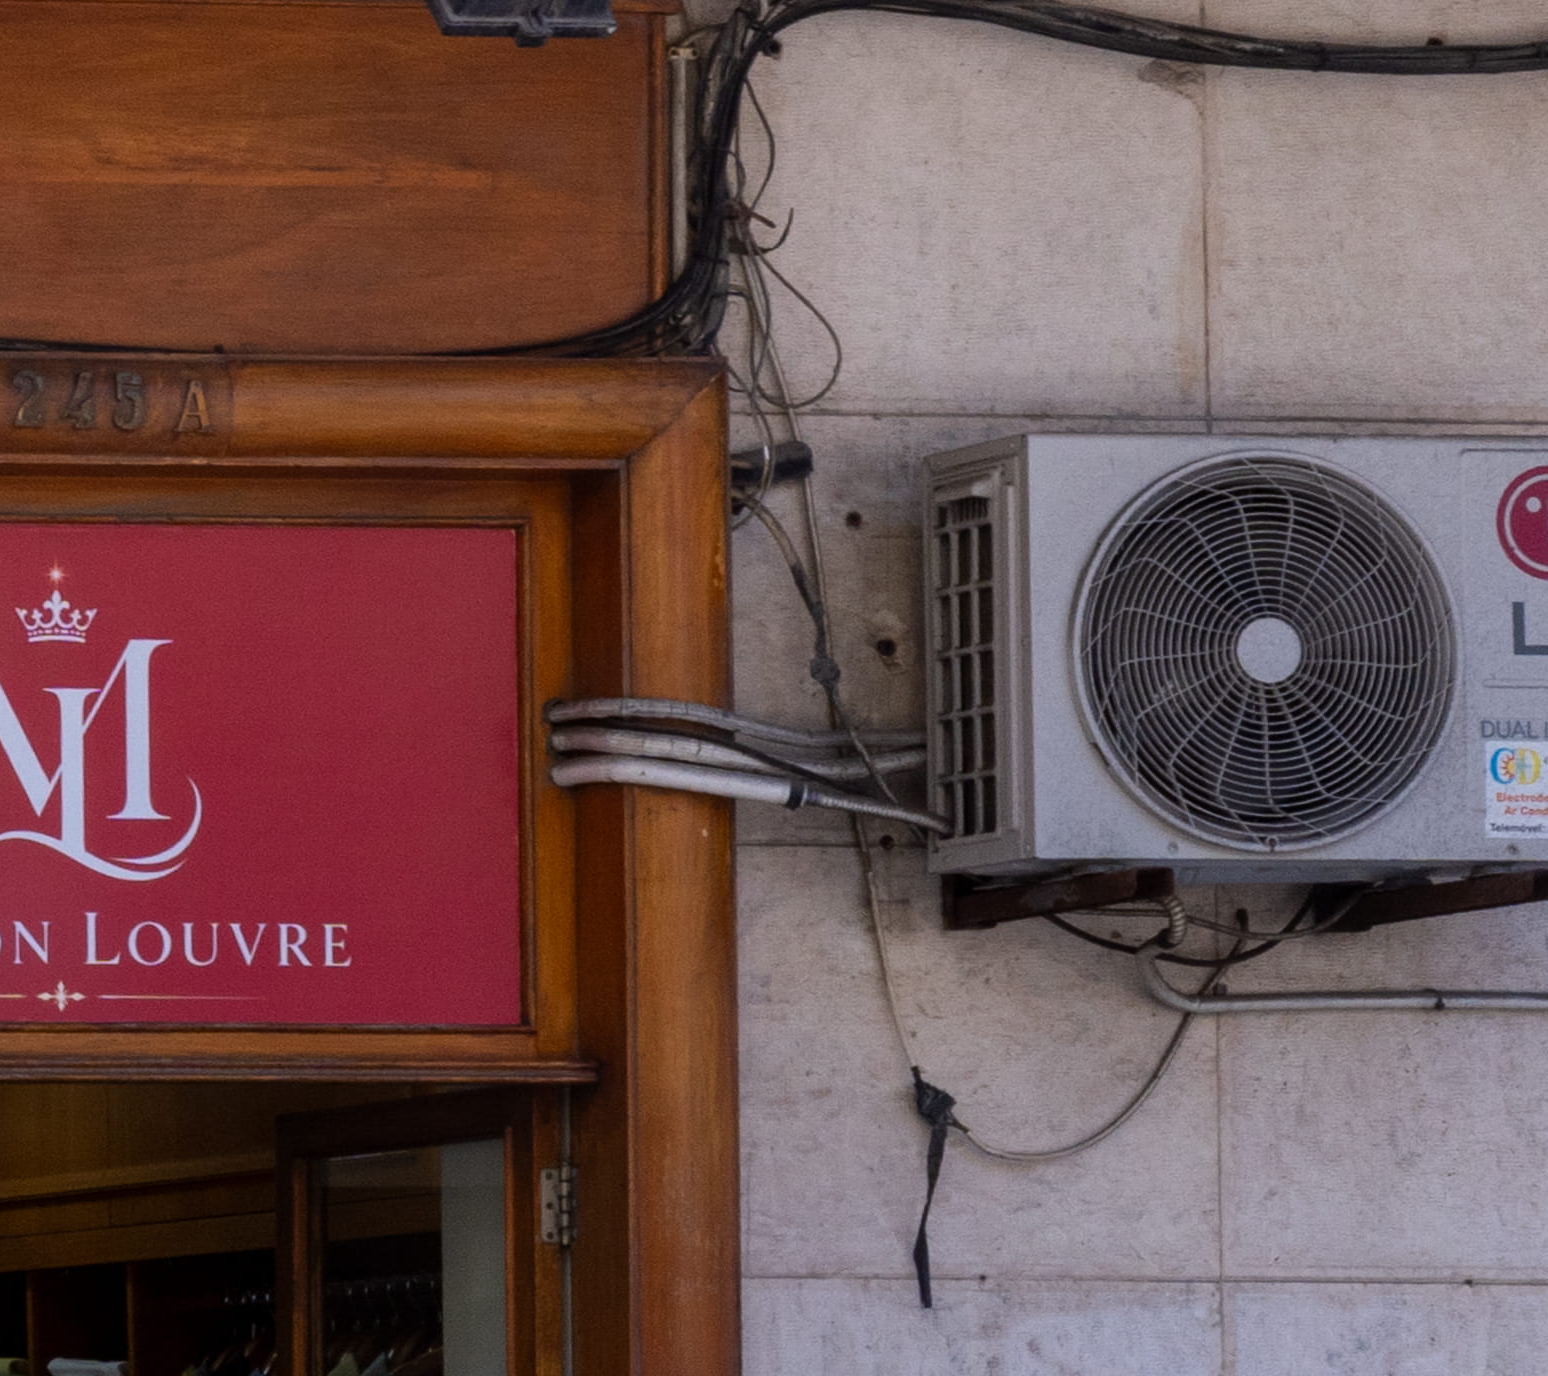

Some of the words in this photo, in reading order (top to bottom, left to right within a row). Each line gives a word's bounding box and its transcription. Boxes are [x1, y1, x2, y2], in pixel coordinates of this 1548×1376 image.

[11, 368, 144, 432] 245
[173, 378, 215, 433] A
[1479, 718, 1540, 740] DUAL
[81, 909, 354, 969] LOUVRE
